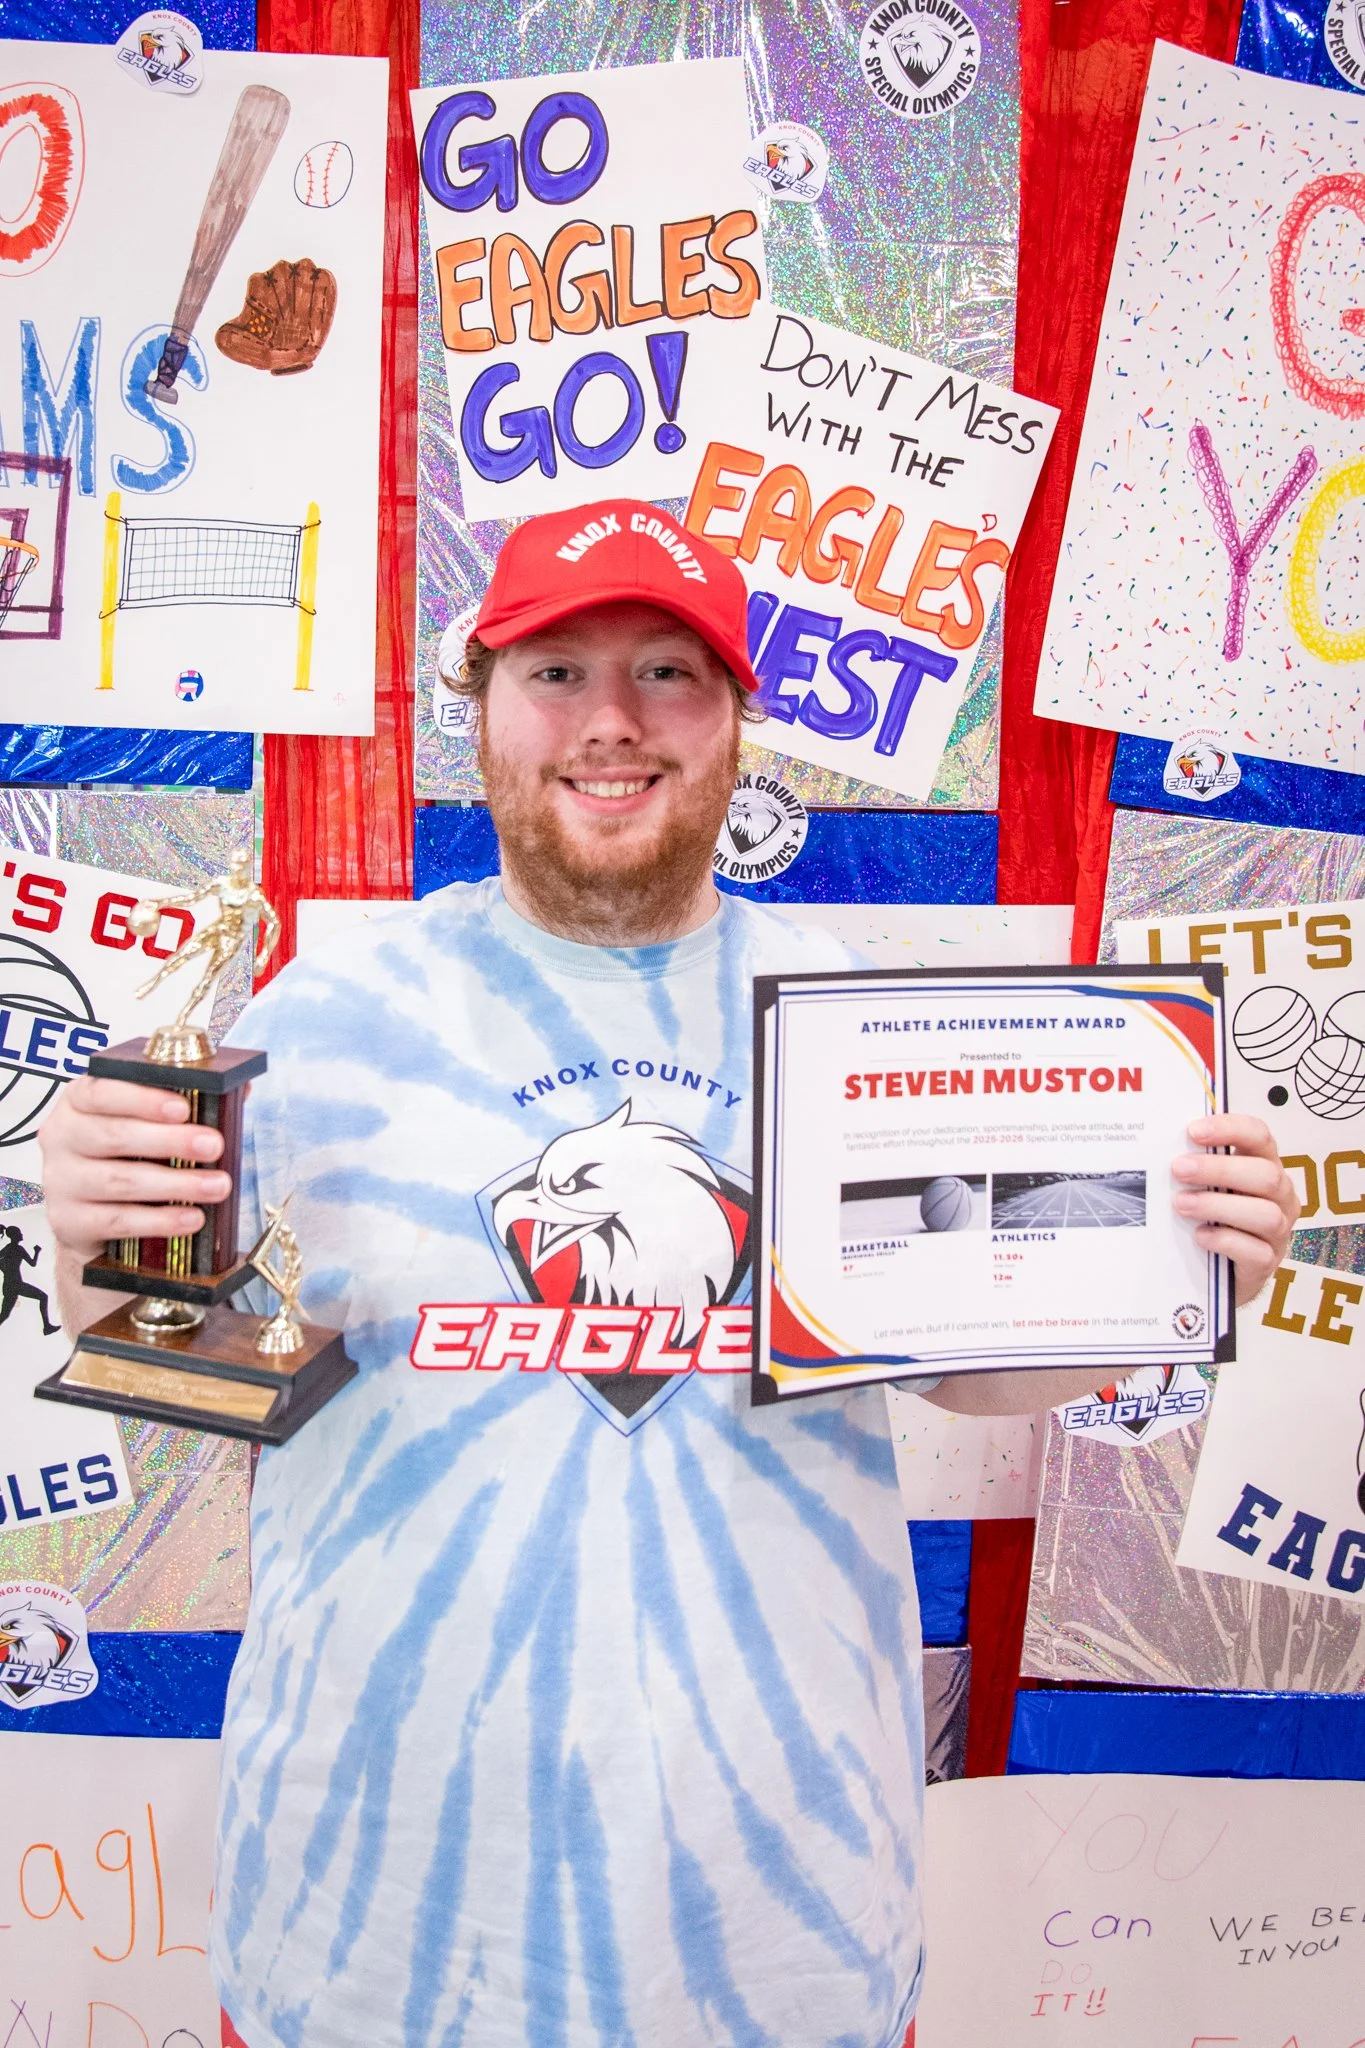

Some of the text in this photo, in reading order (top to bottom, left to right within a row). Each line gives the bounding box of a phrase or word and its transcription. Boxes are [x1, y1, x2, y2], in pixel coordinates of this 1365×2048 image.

[869, 0, 975, 39] KNOX COUNTY
[117, 47, 197, 89] EAGLES
[1328, 18, 1360, 80] SPECIAL
[865, 56, 976, 114] SPECIAL OLYMPICS
[420, 91, 609, 213] GO
[742, 156, 820, 199] EAGLES
[436, 210, 761, 352] EAGLES
[760, 314, 1043, 454] DON'T MESS
[0, 317, 209, 498] MS
[460, 331, 689, 483] GO!
[767, 391, 965, 488] WITH THE
[555, 513, 708, 584] KNOX COUNTY
[684, 442, 1012, 650] EAGLE'S
[1179, 729, 1222, 741] KNOX COUNTY
[755, 776, 806, 820] COUNTY
[1166, 773, 1240, 790] EAGLES
[729, 841, 799, 879] OLYMPICS
[90, 891, 195, 960] GO
[861, 1017, 1126, 1033] ATHLETE ACHIEVEMENT AWARD
[960, 1052, 1022, 1061] Presented to
[511, 1057, 743, 1110] KNOX COUNTY
[844, 1067, 1143, 1100] STEVEN MUSTON
[1025, 1133, 1057, 1144] Special
[1060, 1132, 1101, 1143] Olympics
[1127, 1122, 1145, 1131] and
[841, 1240, 909, 1254] BASKETBALL
[991, 1232, 1057, 1242] ATHLETICS
[409, 1303, 753, 1375] EAGLE
[1012, 1318, 1026, 1328] let
[1028, 1319, 1043, 1328] me
[1060, 1317, 1089, 1327] brave
[1091, 1316, 1101, 1326] in
[1103, 1316, 1119, 1326] the
[1063, 1389, 1207, 1430] EAGLES
[0, 1453, 119, 1526] LES
[25, 1585, 73, 1607] COUNTY
[0, 1662, 94, 1694] GLES
[1025, 1783, 1229, 1888] YOU
[1043, 1910, 1152, 1948] Can
[1209, 1906, 1365, 1942] WE BE
[1237, 1935, 1339, 1966] IN YOU
[1040, 1959, 1092, 1985] DO
